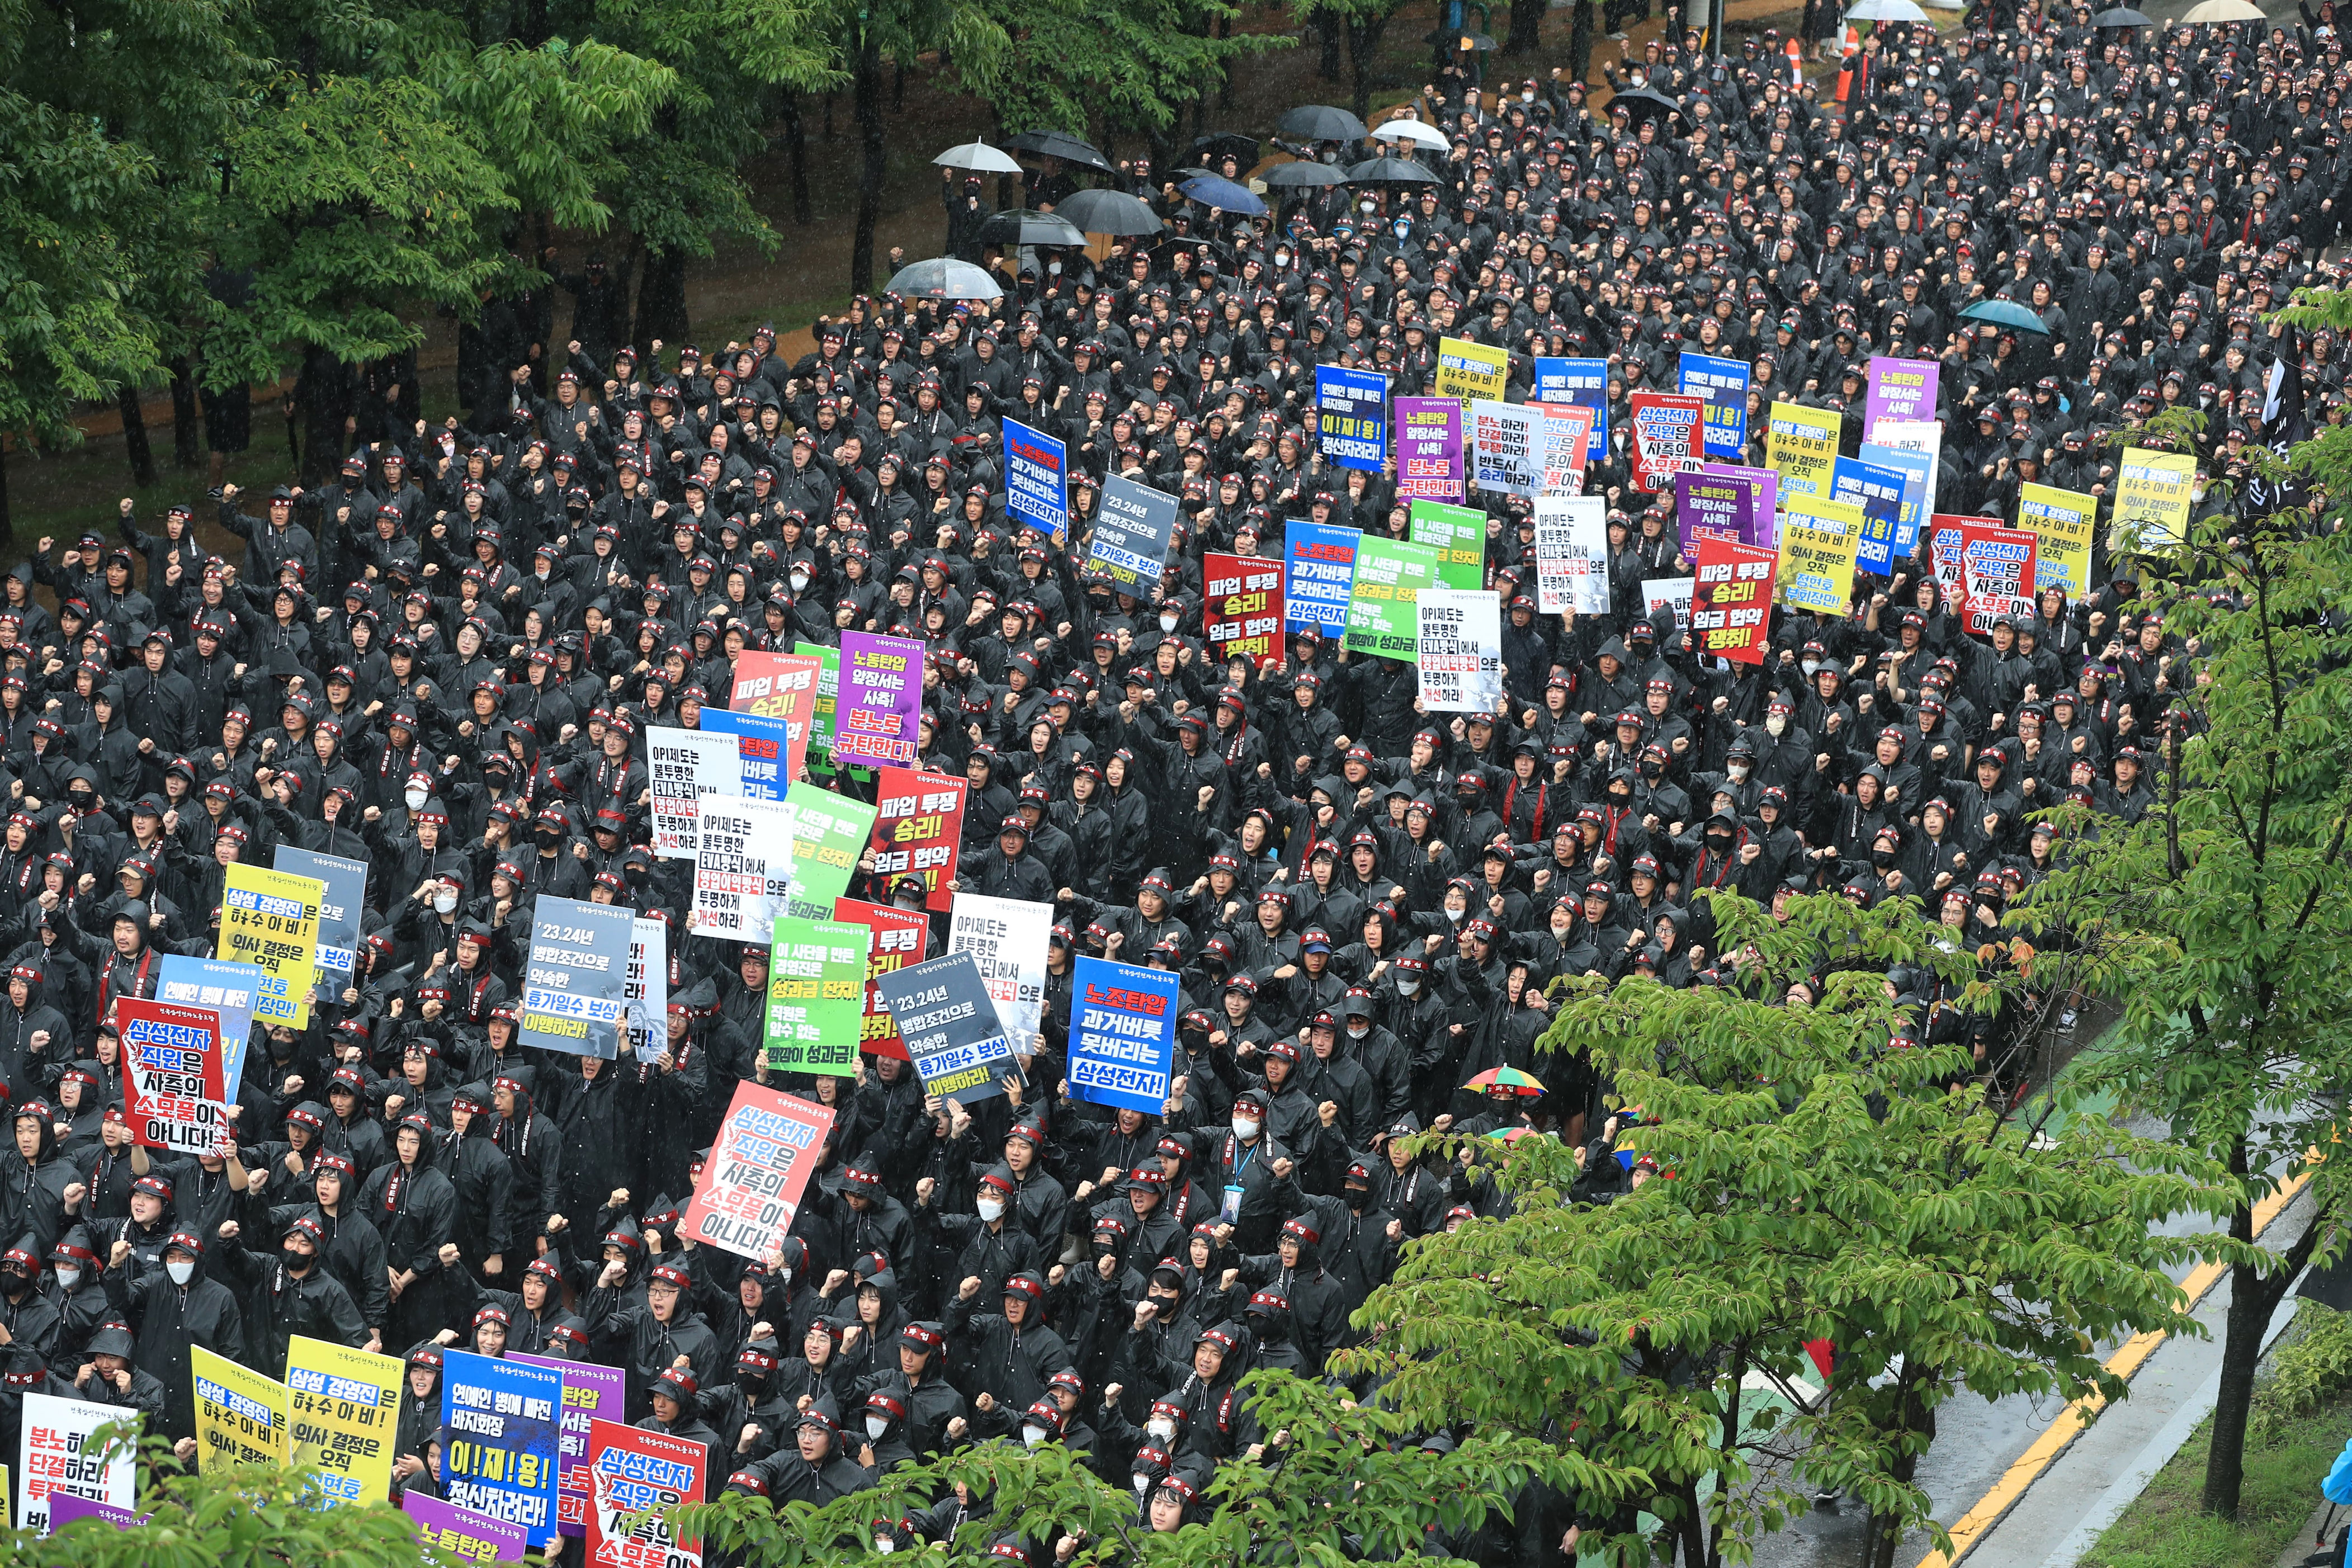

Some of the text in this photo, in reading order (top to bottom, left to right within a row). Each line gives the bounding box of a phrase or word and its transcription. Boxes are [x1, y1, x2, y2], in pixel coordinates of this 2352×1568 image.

[1879, 372, 1925, 386] 노동탄압
[1322, 383, 1381, 403] 연예인 병에 빠진
[1878, 385, 1923, 401] 앞장서는
[1322, 397, 1353, 412] 바지회장
[1887, 402, 1914, 415] 사측!
[1406, 412, 1448, 424] 노동탄압
[1477, 415, 1528, 432] 분노하라!
[1406, 427, 1448, 440] 앞장서는
[1477, 428, 1528, 444] 단결하라!
[1011, 438, 1060, 470] 노조탄압
[1322, 437, 1380, 461] 정신차려라!
[1417, 442, 1442, 455] 사측!
[1479, 441, 1529, 456] 투쟁하라!
[1011, 455, 1059, 488] 과거버릇
[1408, 459, 1451, 476] 분노로
[1480, 456, 1517, 471] 반드시
[1012, 471, 1059, 504] 못버리는
[1402, 479, 1462, 497] 규탄한다!
[1479, 469, 1534, 487] 승리하라!
[1011, 492, 1063, 525] 삼성전자!
[2150, 499, 2180, 512] 결정은
[1099, 511, 1158, 540] 병합조건으로
[1539, 514, 1574, 527] OPI제도는
[1789, 512, 1813, 527] 삼성
[1096, 527, 1126, 546] 약속한
[1541, 530, 1570, 542] 불투명한
[1093, 542, 1160, 575] 휴가일수 보상
[1293, 541, 1354, 563] 노조탄압
[1791, 546, 1846, 565] 의사 결정은
[1970, 540, 2030, 561] 삼성전자
[1292, 561, 1352, 583] 과거버릇
[1699, 561, 1770, 582] 파업 투쟁
[1806, 561, 1827, 574] 오직
[1975, 560, 2021, 579] 직원은
[1292, 579, 1350, 601] 못버리는
[1543, 577, 1572, 589] 투명하게
[1712, 582, 1756, 603] 승리!
[1796, 573, 1834, 592] 정현호
[1974, 577, 2020, 597] 사측의
[1543, 592, 1576, 604] 개선하라!
[1786, 587, 1840, 608] 부회장만!
[1965, 596, 2025, 615] 소모품이
[1422, 608, 1463, 621] OPI제도는
[1693, 608, 1763, 629] 임금 협약
[1423, 624, 1458, 637] 불투명한
[1707, 628, 1751, 649] 쟁취!
[853, 651, 907, 672] 노동탄압
[852, 669, 905, 690] 앞장서는
[1424, 673, 1459, 687] 투명하게
[862, 690, 895, 707] 사측!
[1424, 688, 1462, 702] 개선하라!
[848, 708, 903, 735] 분노로
[838, 731, 915, 762] 규탄한다!
[704, 815, 752, 835] OPI제도는
[703, 834, 744, 853] 불투명한
[228, 889, 257, 907] 삼성
[699, 891, 740, 910] 투명하게
[698, 910, 743, 930] 개선하라!
[232, 934, 304, 961] 의사 결정은
[776, 943, 854, 964] 이 사단을 만든
[254, 955, 280, 973] 오직
[532, 946, 610, 972] 병합조건으로
[775, 959, 823, 977] 경영진은
[530, 968, 570, 989] 약속한
[772, 978, 859, 1000] 성과금 잔치!
[527, 990, 617, 1020] 휴가일수 보상
[1084, 983, 1168, 1016] 노조탄압
[771, 1005, 806, 1022] 직원은
[900, 1001, 976, 1035] 병합조건으로
[129, 1018, 212, 1051] 삼성전자
[523, 1013, 588, 1039] 이행하라!
[769, 1022, 820, 1041] 알수 없는
[1081, 1009, 1164, 1041] 과거버릇
[909, 1032, 949, 1054] 약속한
[1079, 1033, 1160, 1065] 못버리는
[141, 1045, 202, 1074] 직원은
[767, 1046, 854, 1064] 깜깜이 성과금!
[919, 1038, 1007, 1075] 휴가일수 보상
[143, 1071, 206, 1099] 사측의
[927, 1066, 991, 1097] 이행하라!
[1076, 1062, 1163, 1095] 삼성전자!
[135, 1095, 215, 1125] 소모품이
[147, 1120, 214, 1149] 아니다!
[734, 1106, 818, 1149] 삼성전자
[735, 1134, 796, 1172] 직원은
[721, 1162, 786, 1198] 사측의
[702, 1187, 783, 1227] 소모품이
[701, 1213, 769, 1252] 아니다!
[290, 1368, 326, 1392] 삼성
[452, 1383, 552, 1420] 연예인 병에 빠진
[451, 1409, 504, 1437] 바지회장
[295, 1423, 380, 1458] 의사 결정은
[29, 1453, 110, 1484] 단결하라!
[318, 1449, 352, 1471] 오직
[601, 1448, 695, 1492] 삼성전자
[448, 1480, 547, 1527] 정신차려라!
[419, 1523, 499, 1563] 노동탄압
